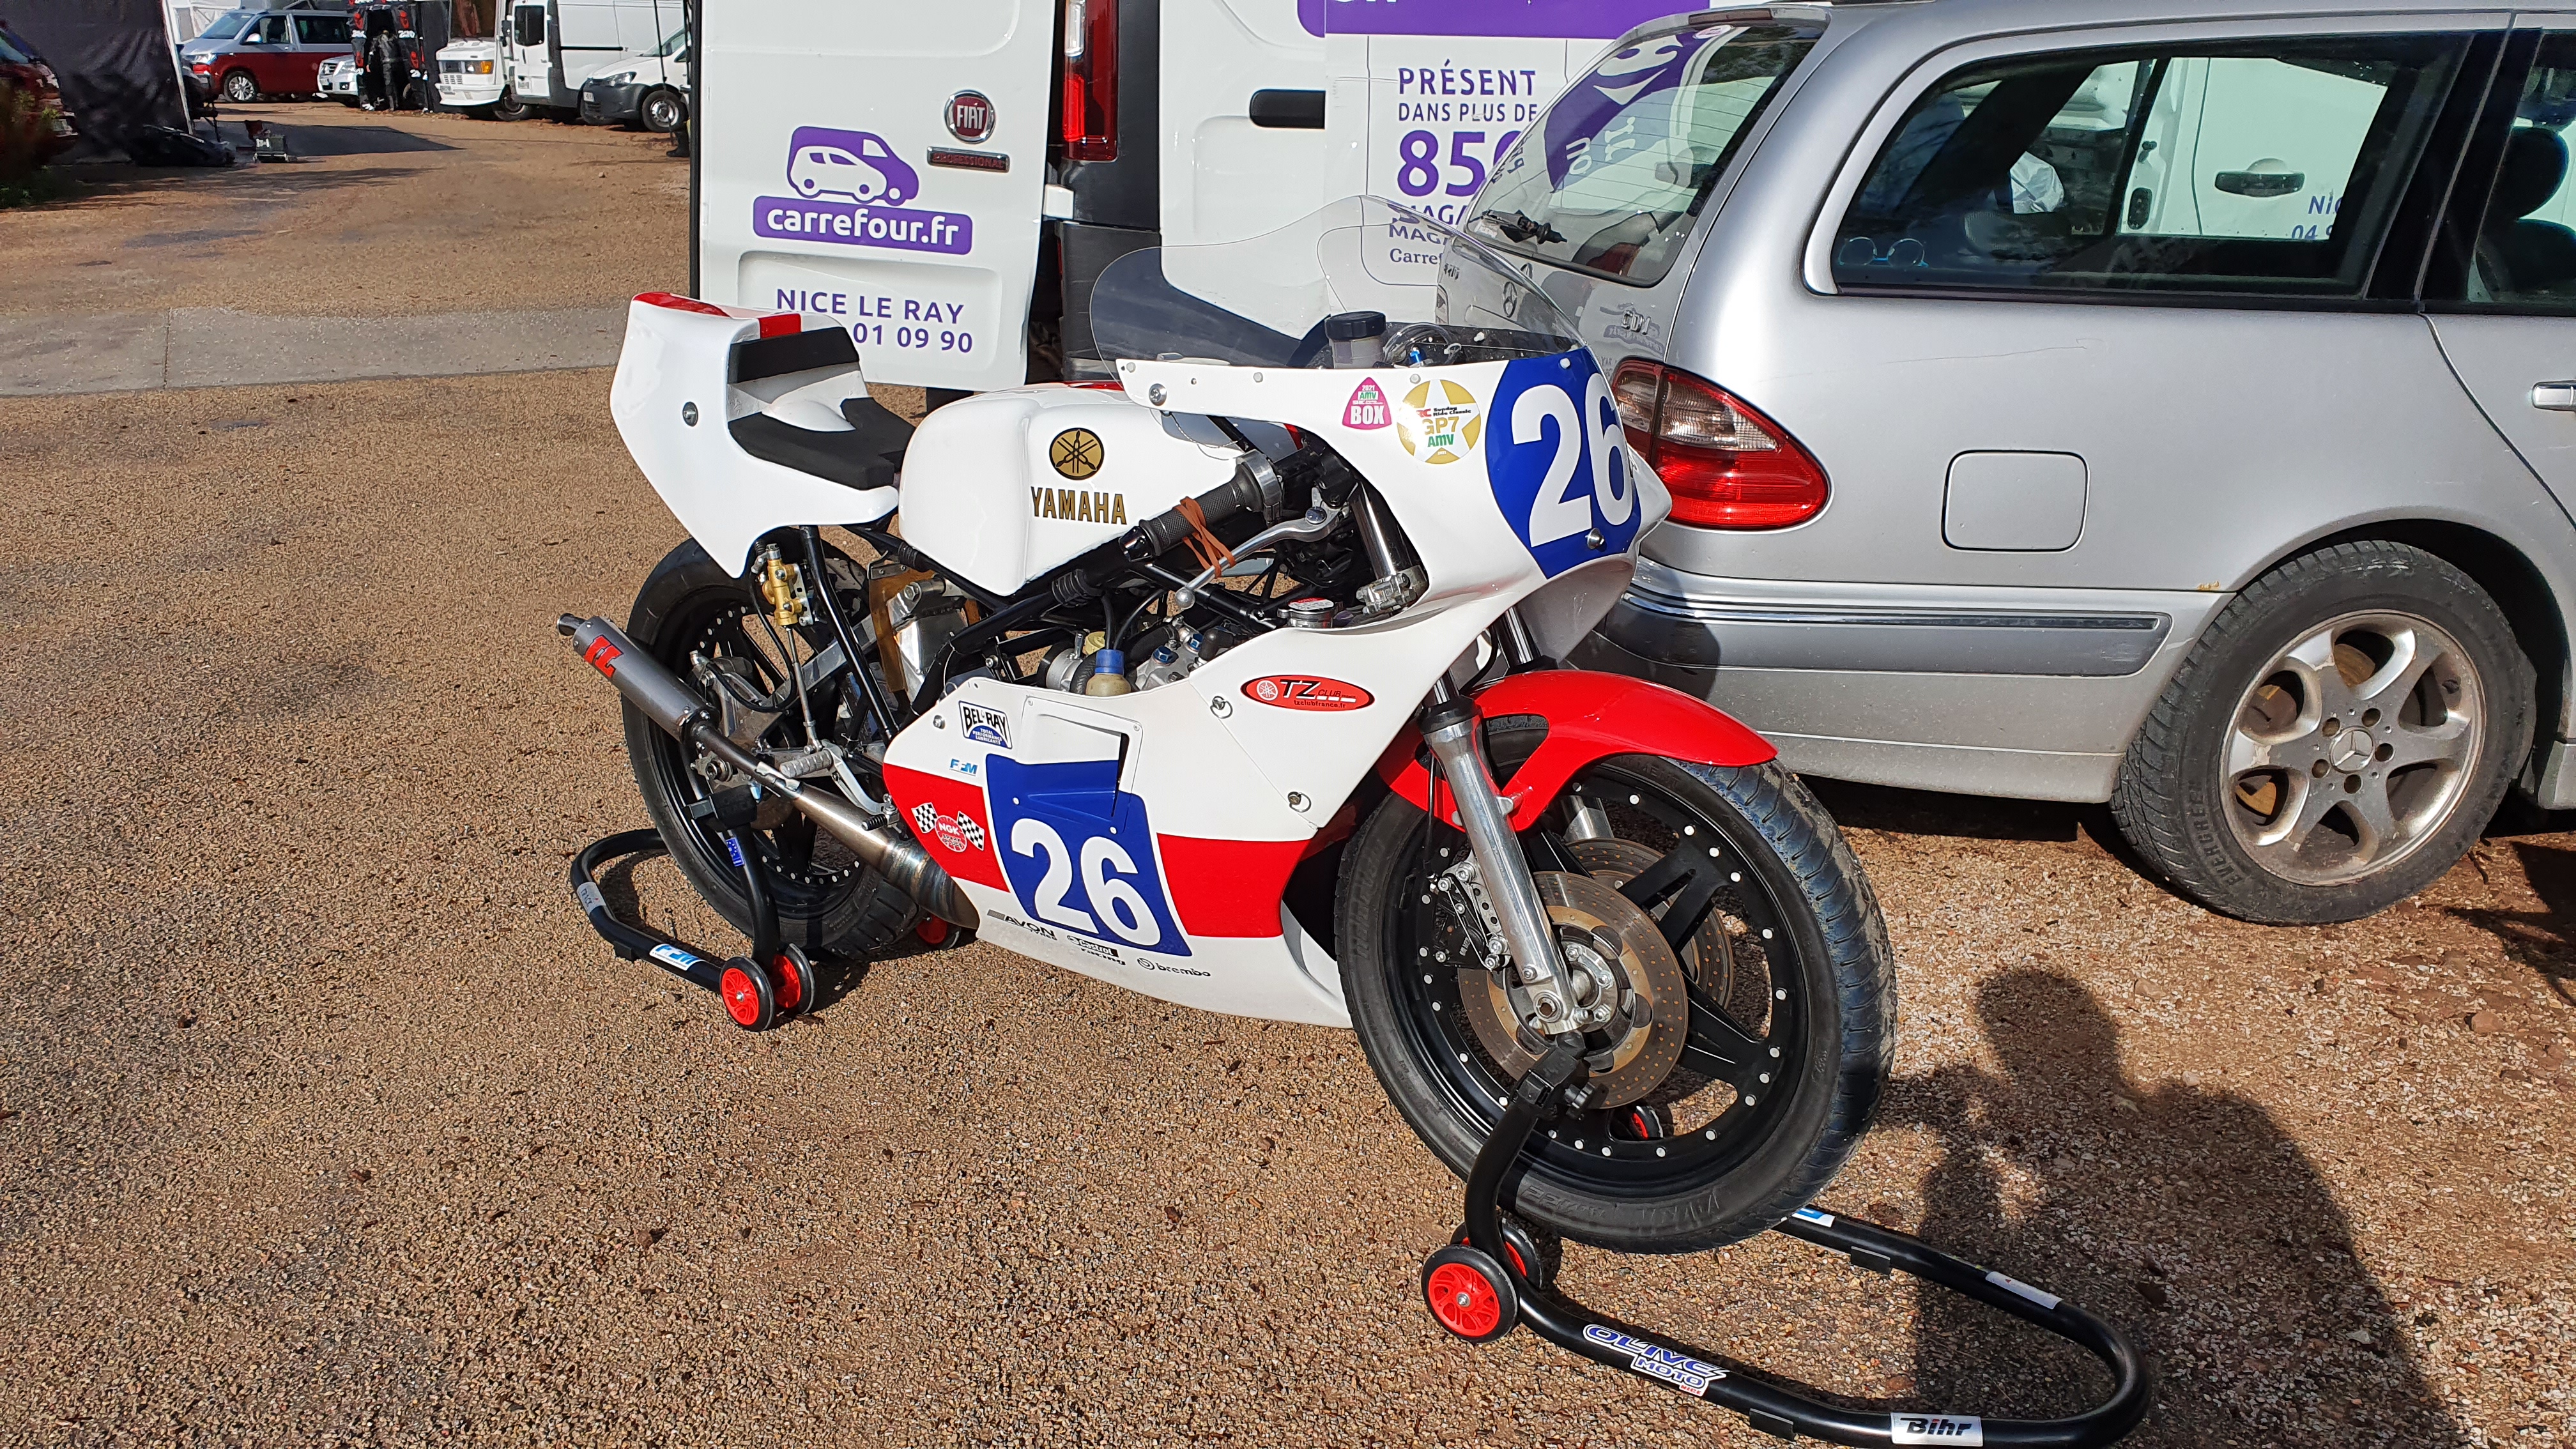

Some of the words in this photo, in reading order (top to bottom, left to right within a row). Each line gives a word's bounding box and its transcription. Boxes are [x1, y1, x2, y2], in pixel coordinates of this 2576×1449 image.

[1398, 59, 1536, 96] PRÉSENT
[956, 105, 985, 130] FIAT
[1399, 103, 1450, 121] DANS
[1460, 103, 1505, 121] PLUS
[933, 153, 1003, 169] PROFESSIONAL
[767, 208, 959, 246] carrefour.fr
[777, 289, 847, 314] NICE
[859, 296, 892, 319] LE
[904, 300, 964, 324] RAY
[1621, 310, 1652, 335] CDI
[853, 323, 883, 346] 01
[897, 326, 929, 349] 09
[940, 330, 973, 353] 90
[1350, 405, 1385, 425] BOX
[1422, 416, 1459, 435] GP7
[1427, 434, 1454, 447] AMV
[1511, 372, 1634, 548] 26
[1031, 486, 1127, 525] YAMAHA
[1279, 678, 1321, 699] TZ
[1318, 689, 1341, 697] CLUB
[1293, 700, 1346, 708] tzclubfrance.fr
[938, 822, 960, 836] NGK
[1011, 818, 1162, 946] 26
[1005, 916, 1055, 937] AVON
[1078, 939, 1114, 956] Castrol
[1155, 962, 1211, 977] brembo
[1587, 1325, 1722, 1377] OLIVE
[1637, 1358, 1703, 1387] MOTO
[1680, 1384, 1702, 1395] NICE
[1900, 1417, 1972, 1436] Bihr
